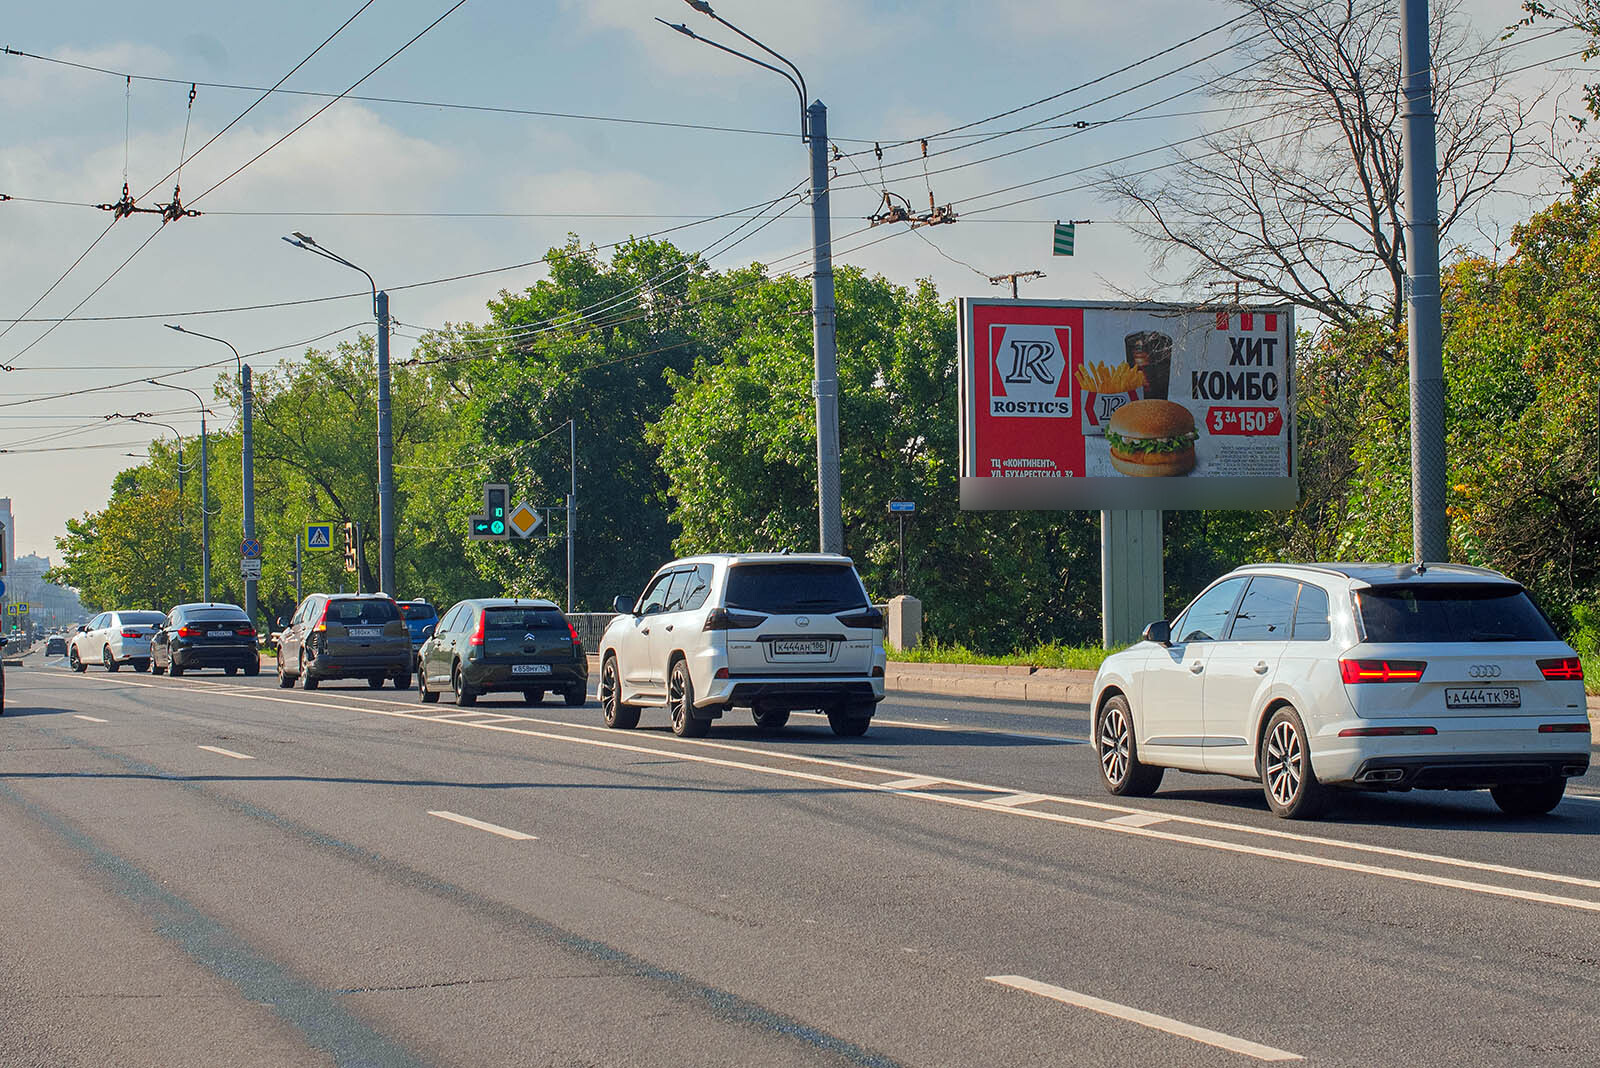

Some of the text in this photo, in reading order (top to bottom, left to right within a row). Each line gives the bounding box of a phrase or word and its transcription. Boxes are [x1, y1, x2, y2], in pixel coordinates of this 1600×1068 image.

[1005, 340, 1055, 384] R
[1229, 337, 1278, 366] ХИТ
[1191, 371, 1279, 401] КОМБО
[993, 401, 1069, 413] ROSTIC'S
[991, 458, 1057, 470] ТЦ «КОНТИНЕНТ»,
